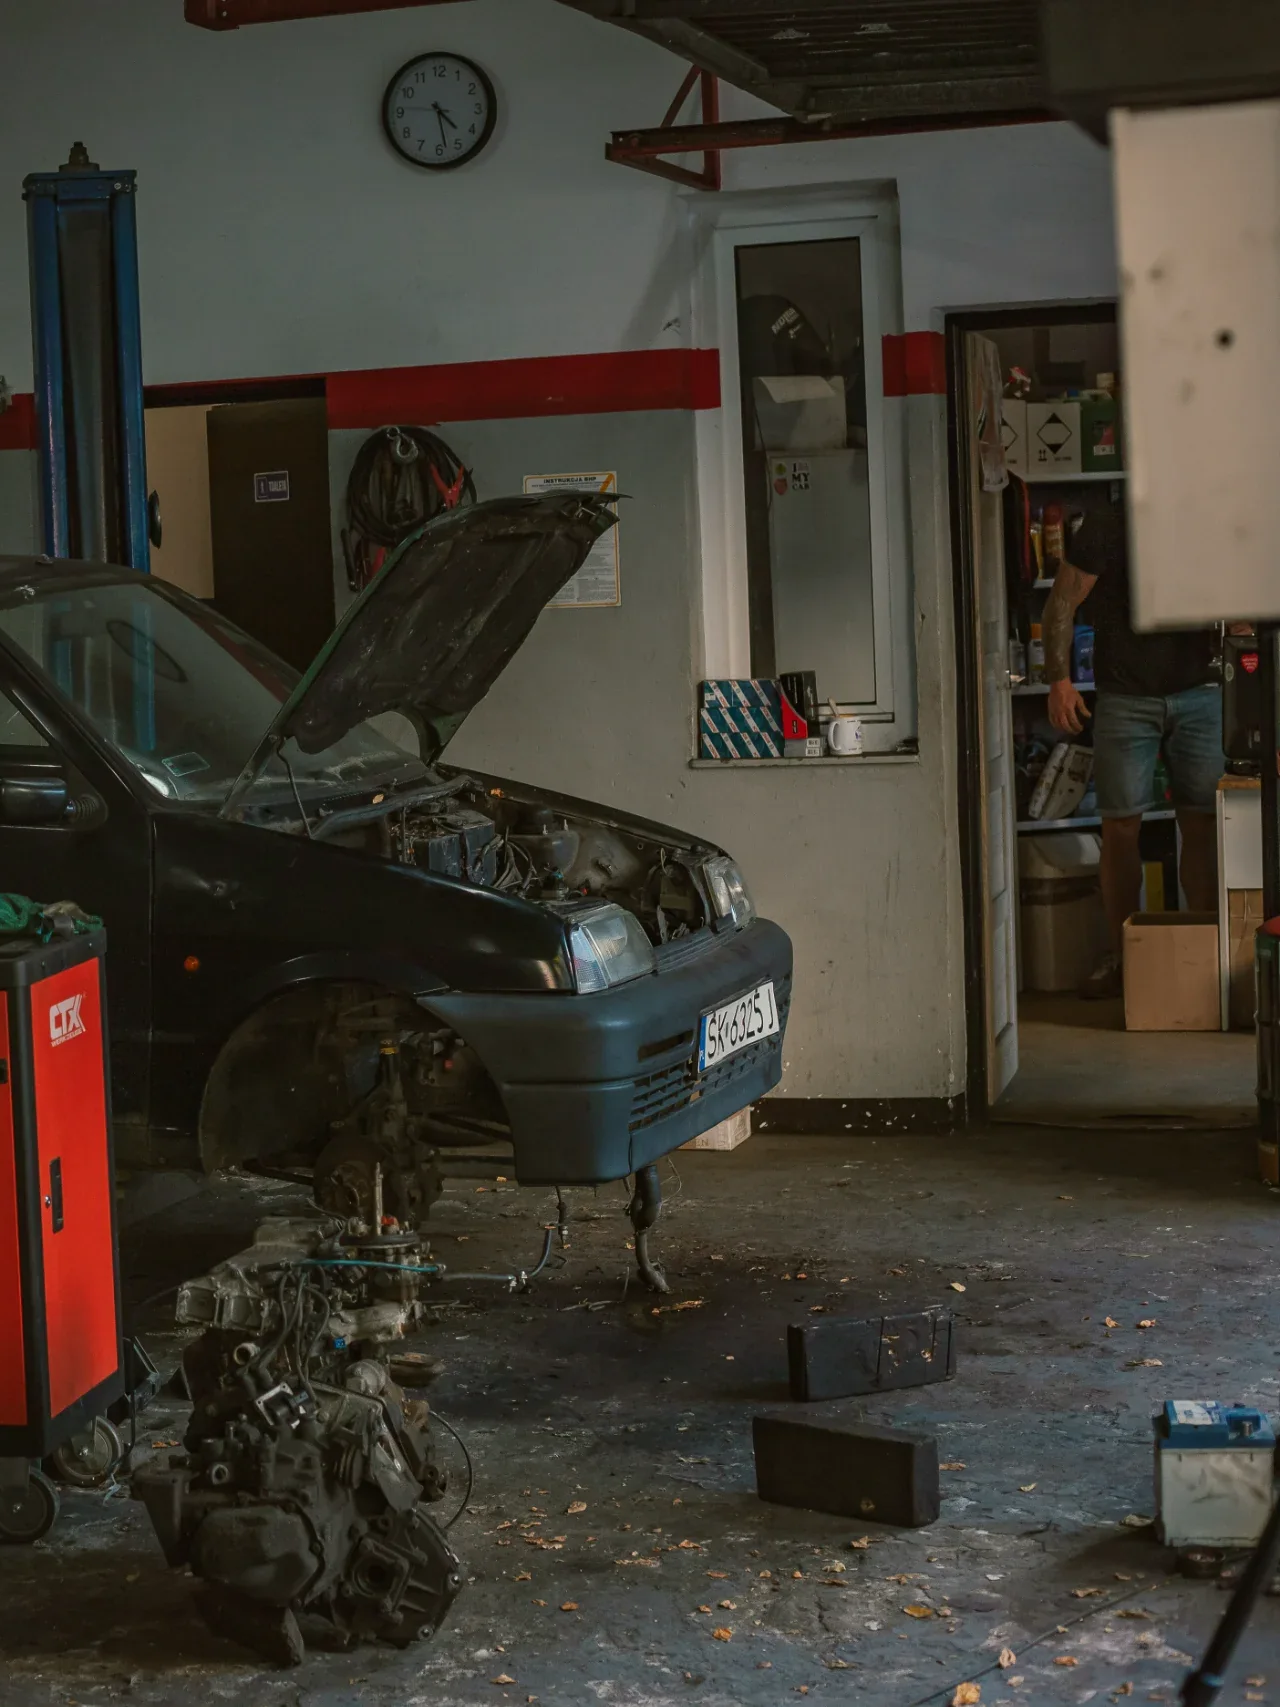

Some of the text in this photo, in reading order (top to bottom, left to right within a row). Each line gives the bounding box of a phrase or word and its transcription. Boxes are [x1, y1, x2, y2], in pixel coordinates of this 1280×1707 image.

[414, 72, 425, 83] 11
[432, 65, 447, 78] 12
[402, 86, 415, 99] 10
[467, 82, 477, 95] 2
[396, 106, 405, 119] 9
[473, 102, 483, 115] 3
[402, 126, 411, 139] 8
[468, 123, 476, 135] 4
[417, 139, 425, 151] 7
[435, 144, 444, 156] 6
[453, 138, 462, 150] 5
[49, 993, 86, 1041] CTX
[707, 1011, 728, 1059] SK
